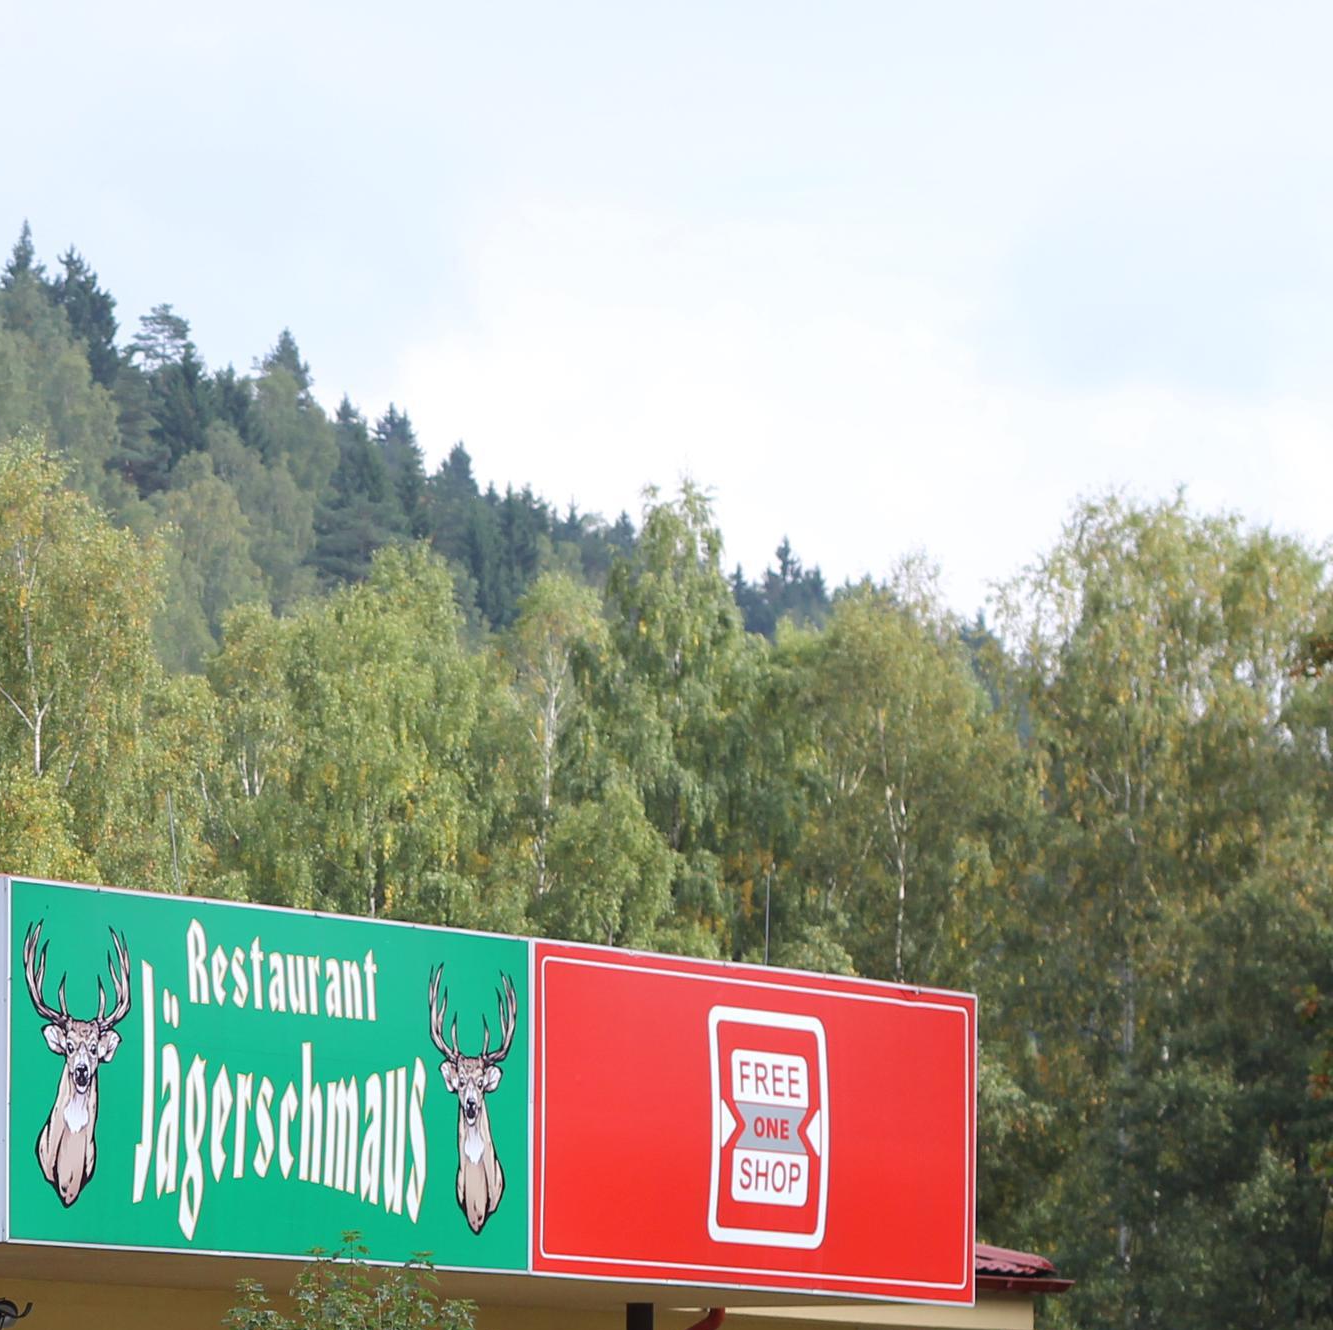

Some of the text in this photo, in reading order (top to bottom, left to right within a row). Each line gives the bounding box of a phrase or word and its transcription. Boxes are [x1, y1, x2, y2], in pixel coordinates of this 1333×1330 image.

[186, 918, 378, 1021] Restaurant
[739, 1060, 801, 1099] FREE
[132, 959, 427, 1241] Jägerschmaus
[753, 1116, 790, 1140] ONE
[739, 1157, 801, 1194] SHOP
